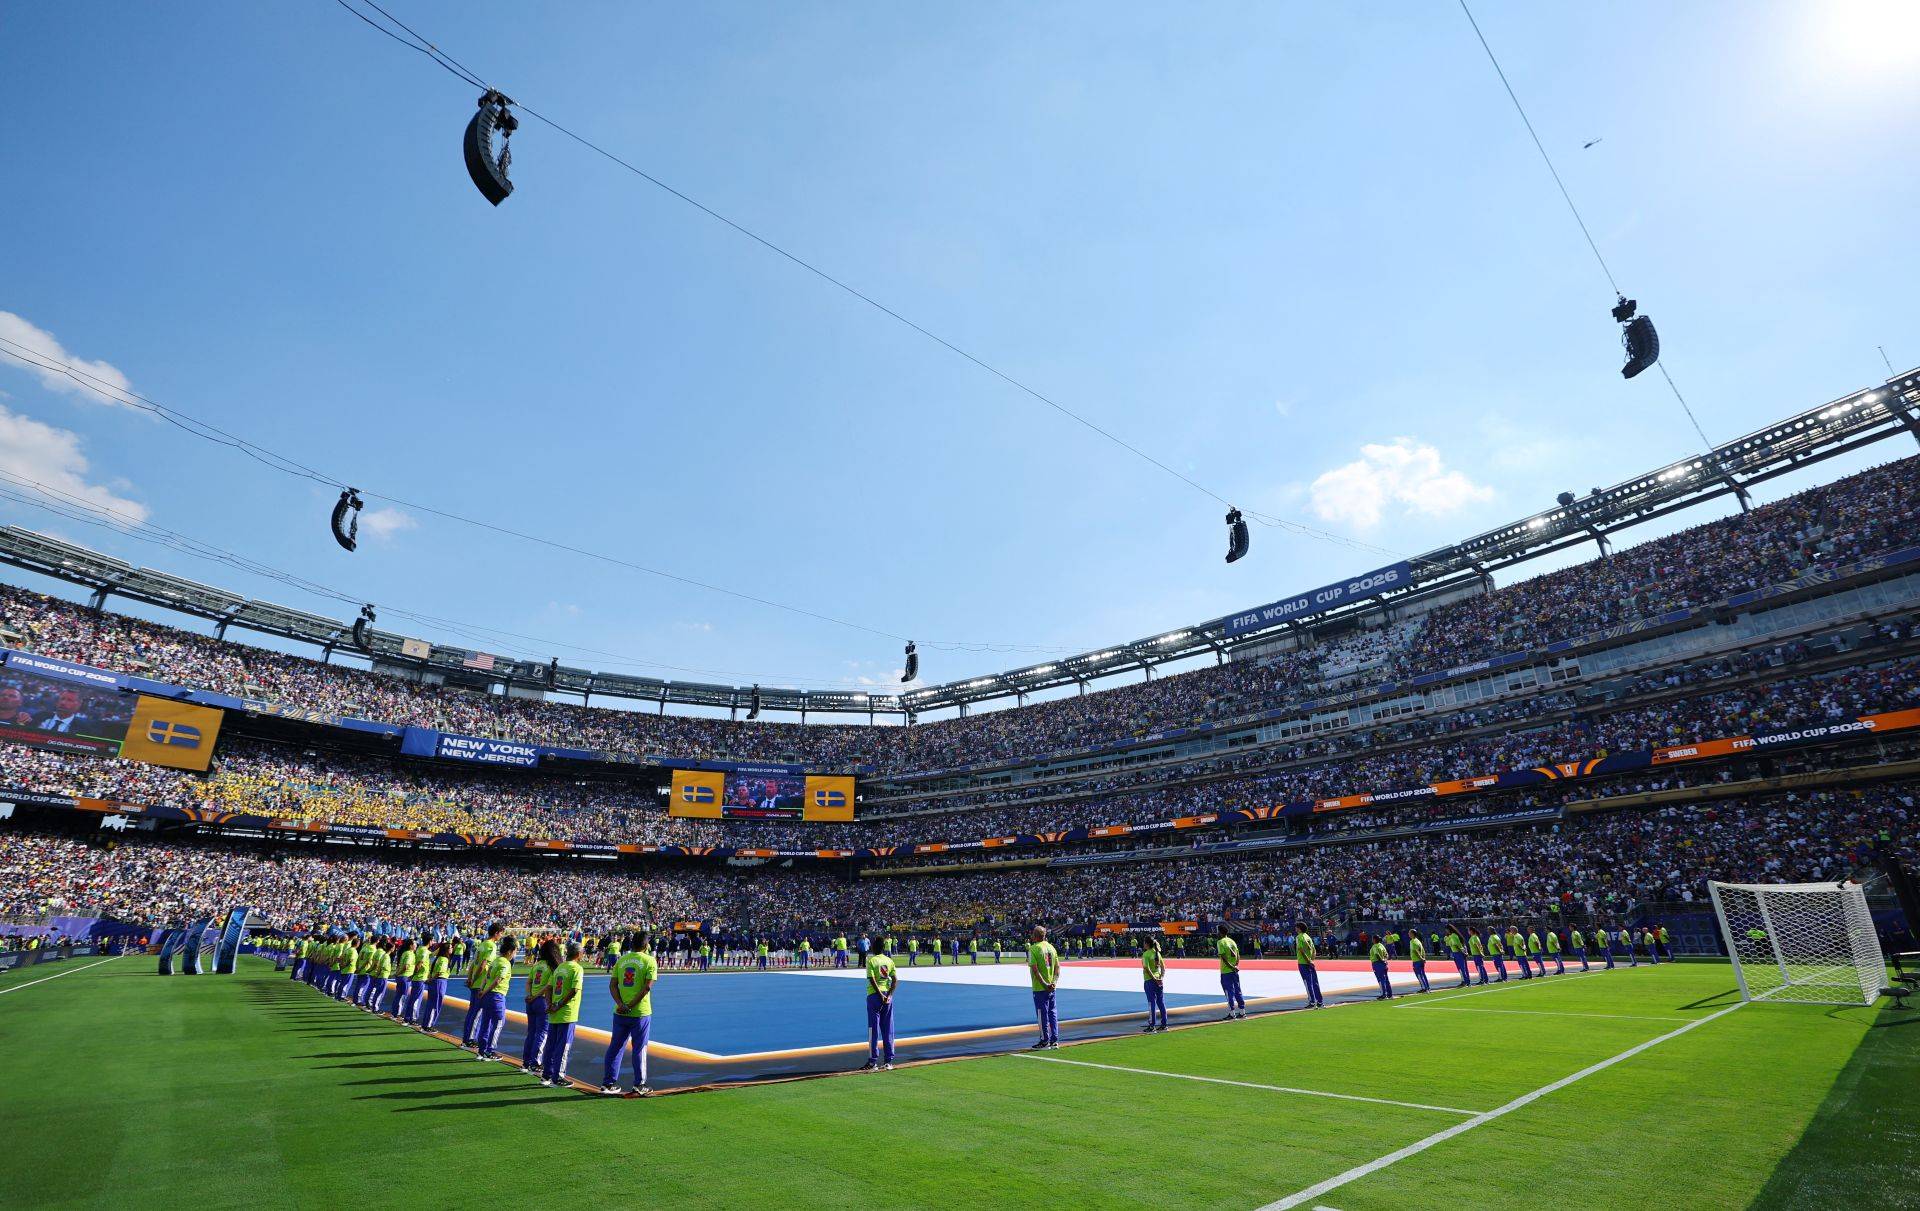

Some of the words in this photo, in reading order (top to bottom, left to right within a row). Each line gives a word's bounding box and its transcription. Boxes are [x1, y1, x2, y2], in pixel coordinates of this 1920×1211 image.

[1232, 613, 1259, 629] FIFA
[1263, 598, 1309, 620] WORLD
[1316, 587, 1343, 604] CUP
[1348, 569, 1399, 595] 2026
[12, 656, 34, 666] FIFA
[34, 660, 67, 673] WORLD
[67, 668, 86, 677] CUP
[86, 673, 117, 684] 2026
[1732, 738, 1757, 749] FIFA
[1758, 732, 1801, 746] WORLD
[1802, 727, 1827, 738] CUP
[1829, 720, 1876, 735] 2026
[441, 748, 476, 759] NEW
[477, 753, 535, 765] JERSEY
[443, 738, 485, 750] NEW
[489, 743, 537, 757] YORK
[1668, 747, 1697, 759] SWEDEN
[0, 791, 30, 801] WORLD
[31, 795, 49, 803] CUP
[49, 797, 80, 806] 2026
[1375, 792, 1399, 801] WORLD
[1413, 786, 1438, 796] 2026
